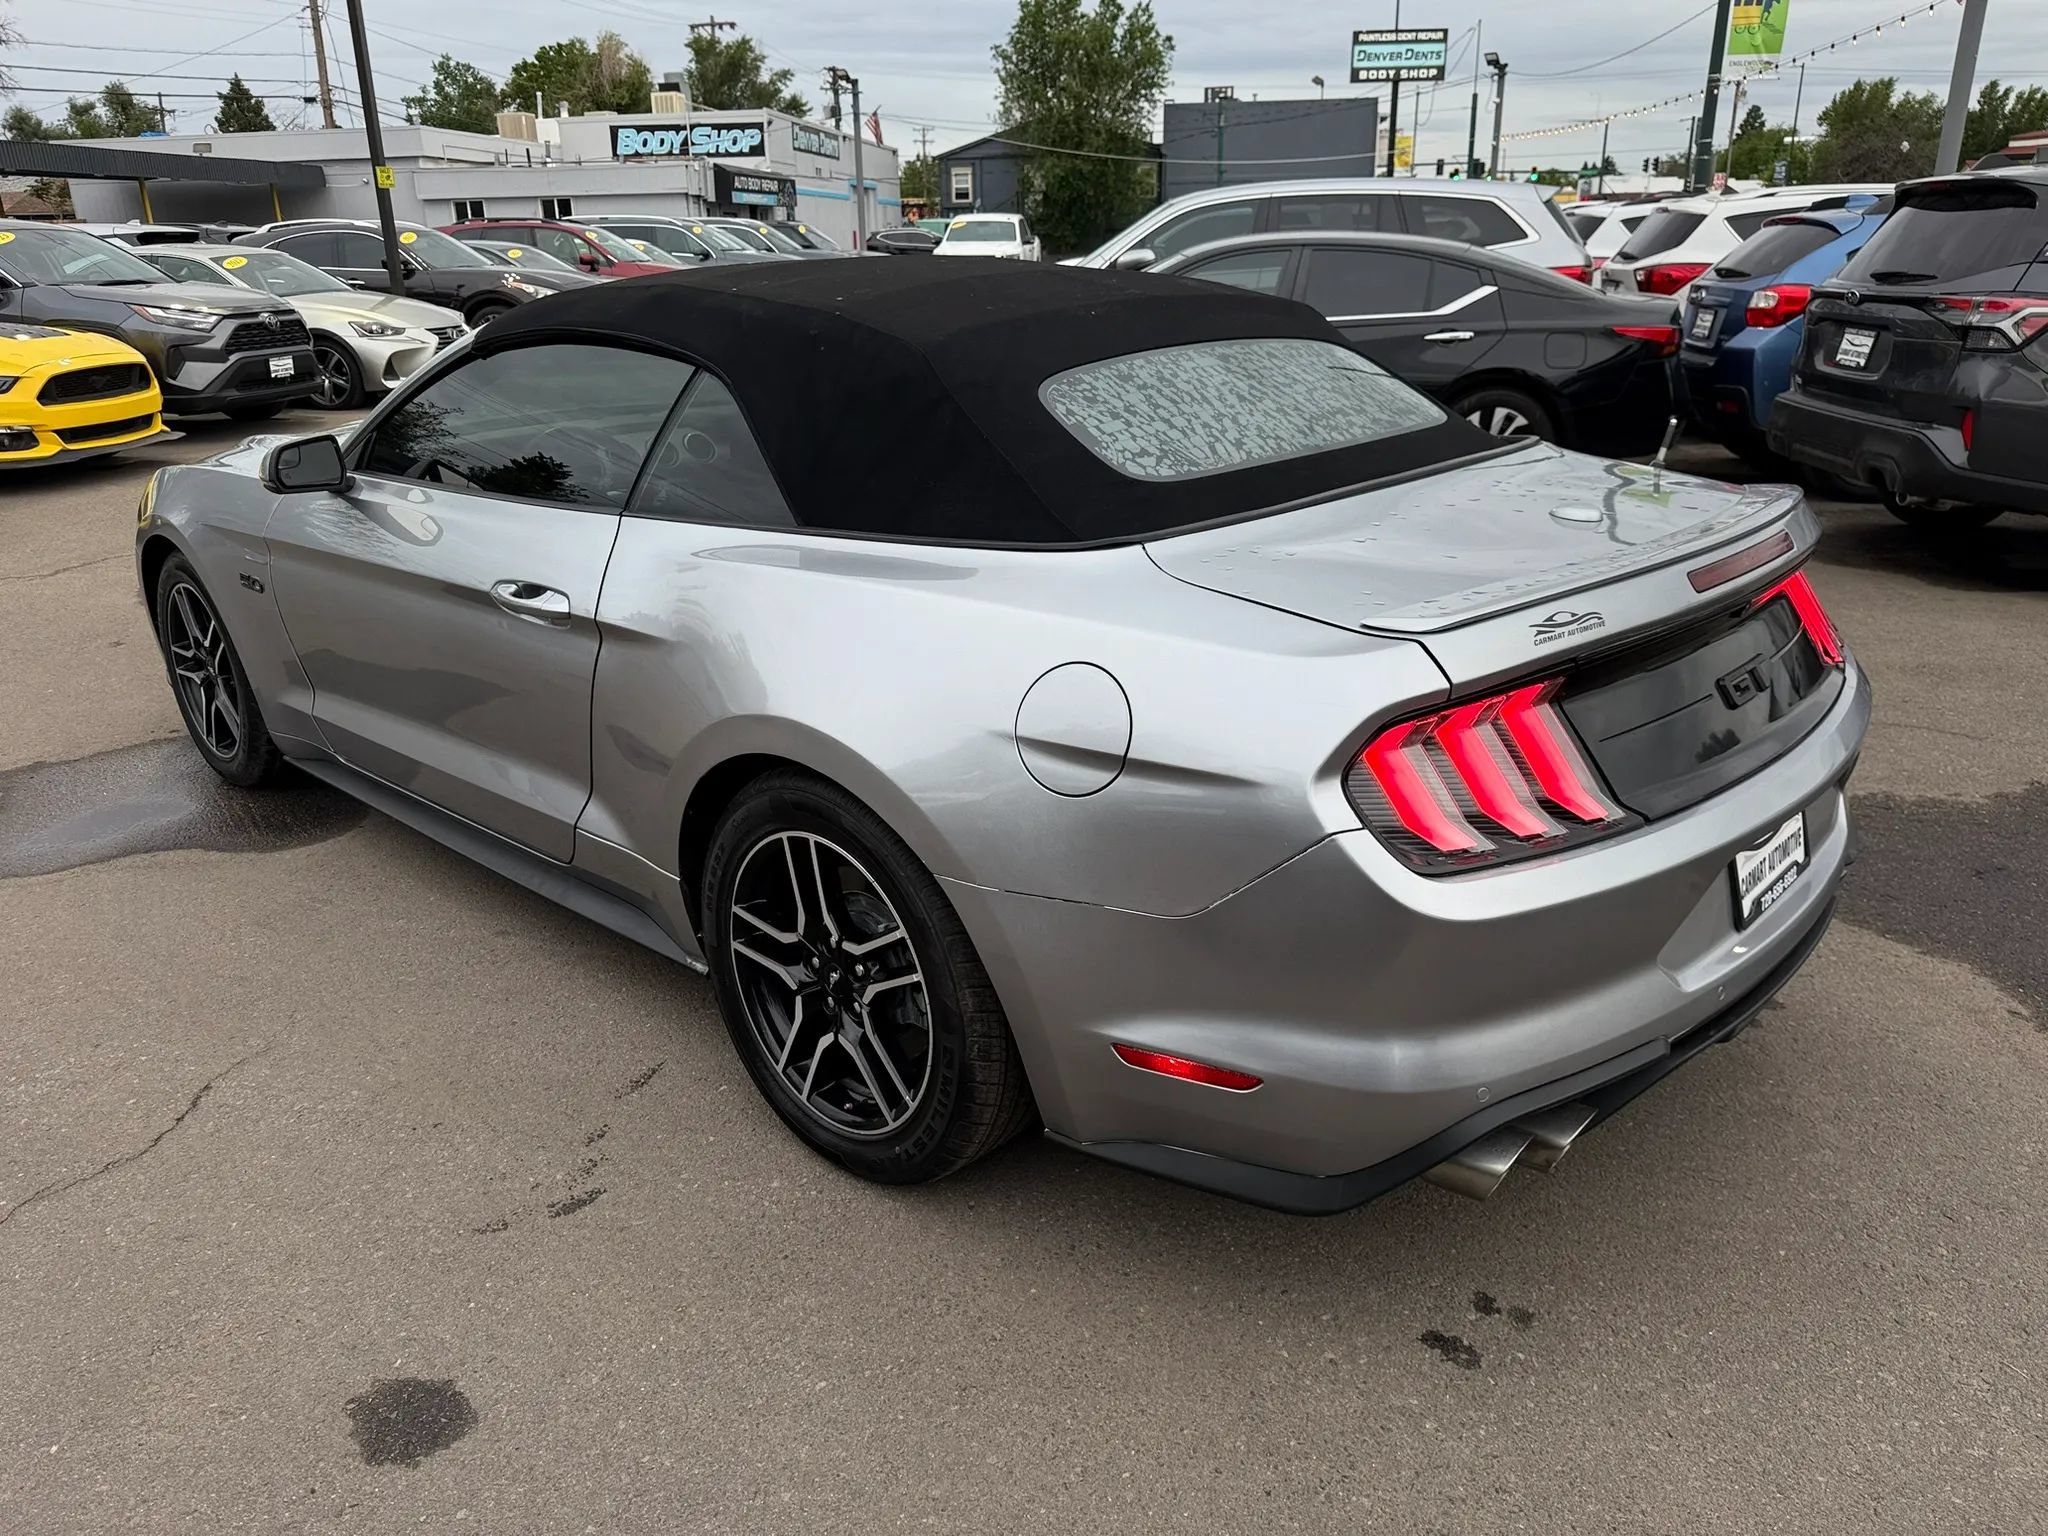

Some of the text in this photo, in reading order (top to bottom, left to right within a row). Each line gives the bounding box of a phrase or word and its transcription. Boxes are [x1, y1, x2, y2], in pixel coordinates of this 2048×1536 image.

[1356, 48, 1442, 62] DENVER DENTS
[1358, 68, 1438, 79] BODY SHOP
[616, 126, 762, 155] BODY SHOP
[734, 175, 779, 192] AUTO BODY REPAIR
[1534, 620, 1606, 646] CARMART AUTOMOTIVE
